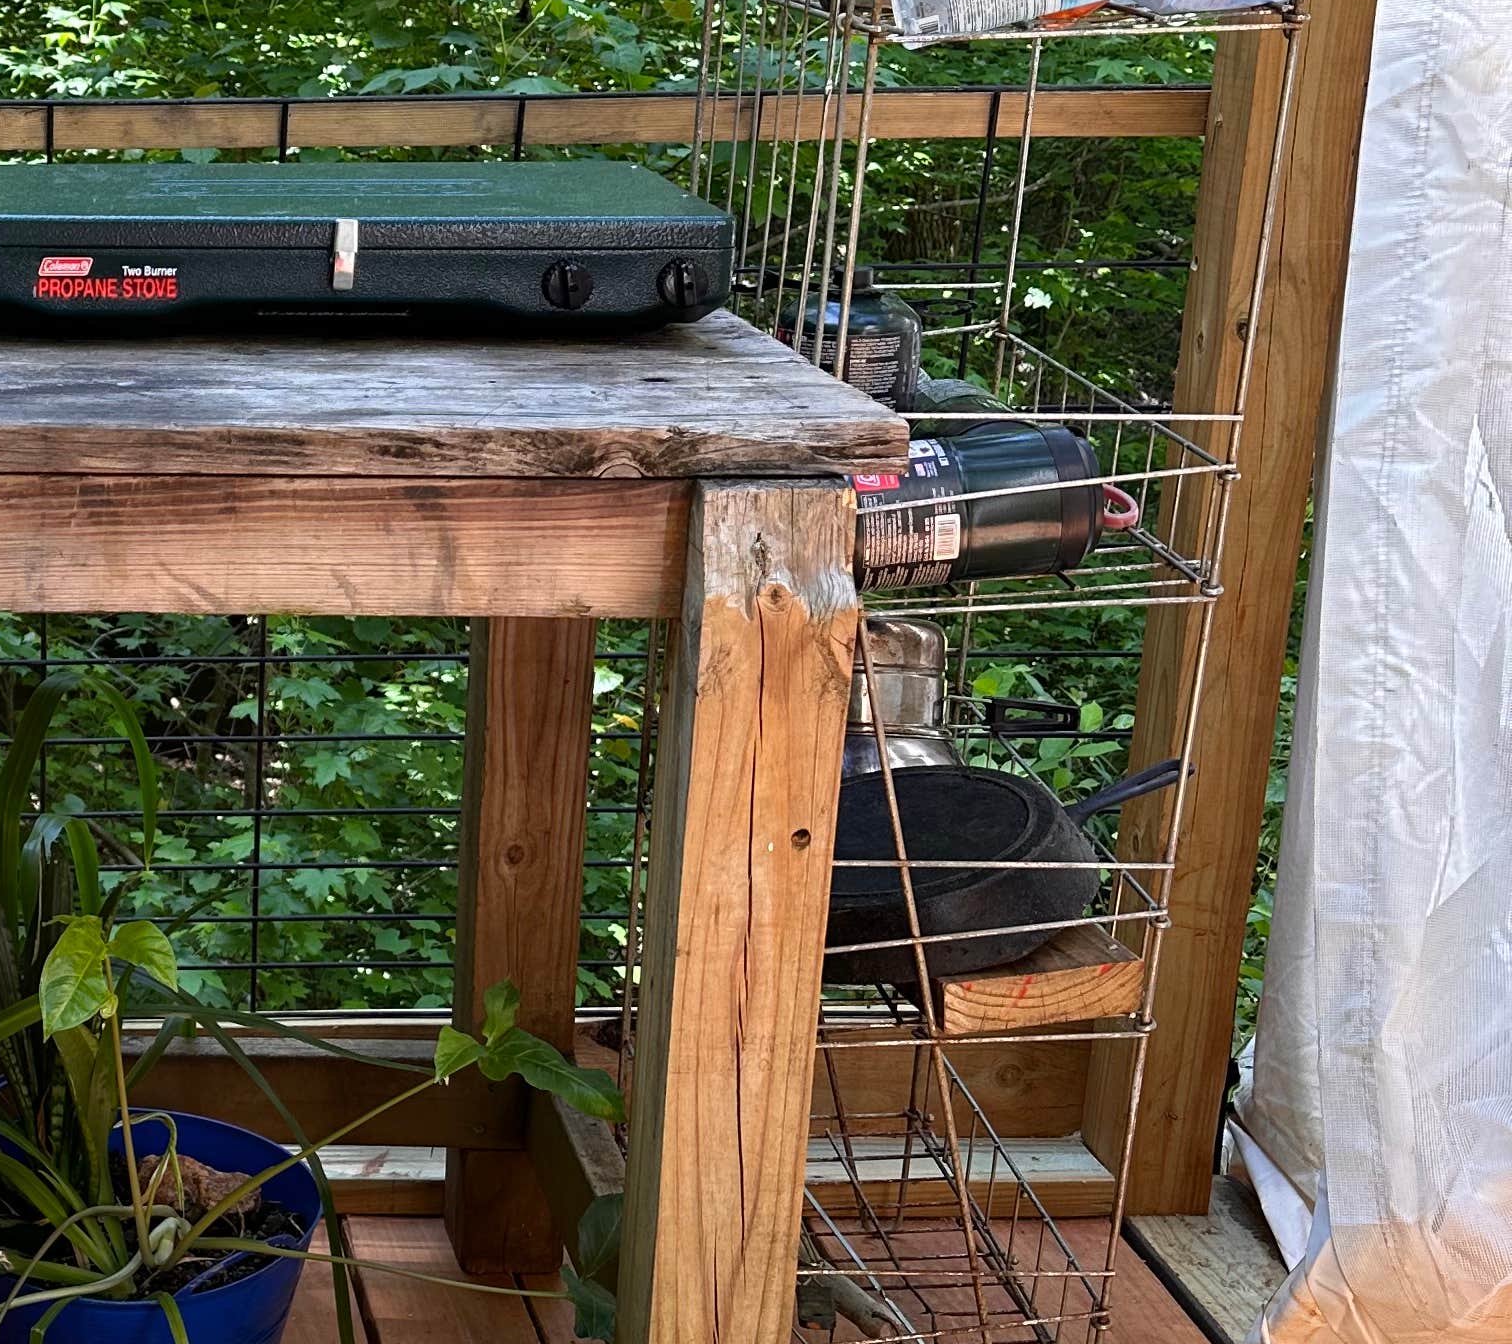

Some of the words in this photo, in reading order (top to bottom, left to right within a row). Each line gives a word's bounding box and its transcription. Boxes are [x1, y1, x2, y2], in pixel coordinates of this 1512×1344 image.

[42, 259, 82, 273] Coleman
[121, 265, 142, 277] Two
[143, 265, 178, 277] Burner
[38, 278, 119, 298] PROPANE
[122, 278, 178, 299] STOVE
